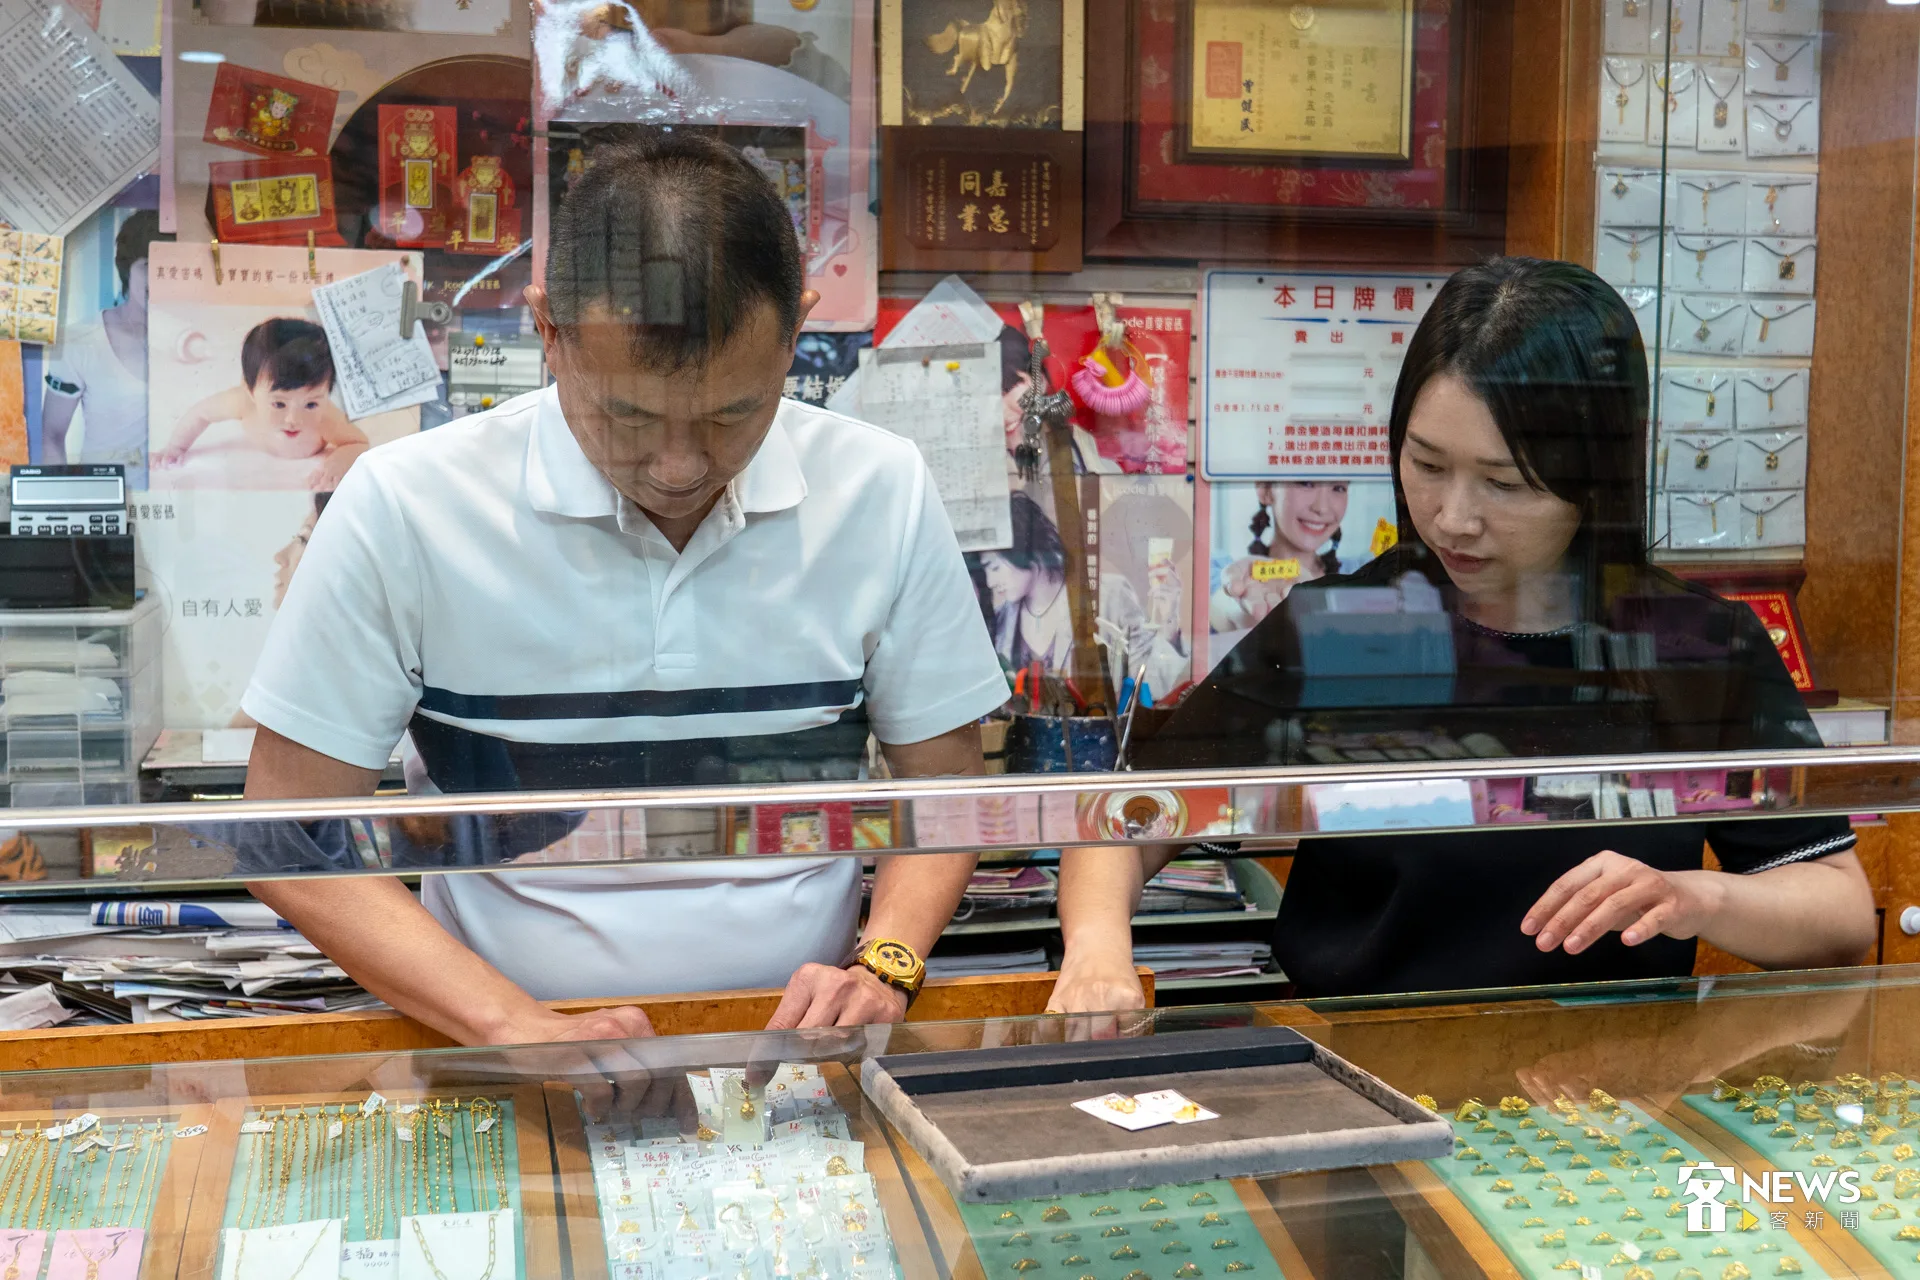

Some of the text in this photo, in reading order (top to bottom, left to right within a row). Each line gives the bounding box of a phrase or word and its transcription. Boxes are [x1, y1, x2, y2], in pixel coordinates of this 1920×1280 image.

[1273, 284, 1415, 311] 本日牌價
[182, 599, 262, 617] 自有人愛
